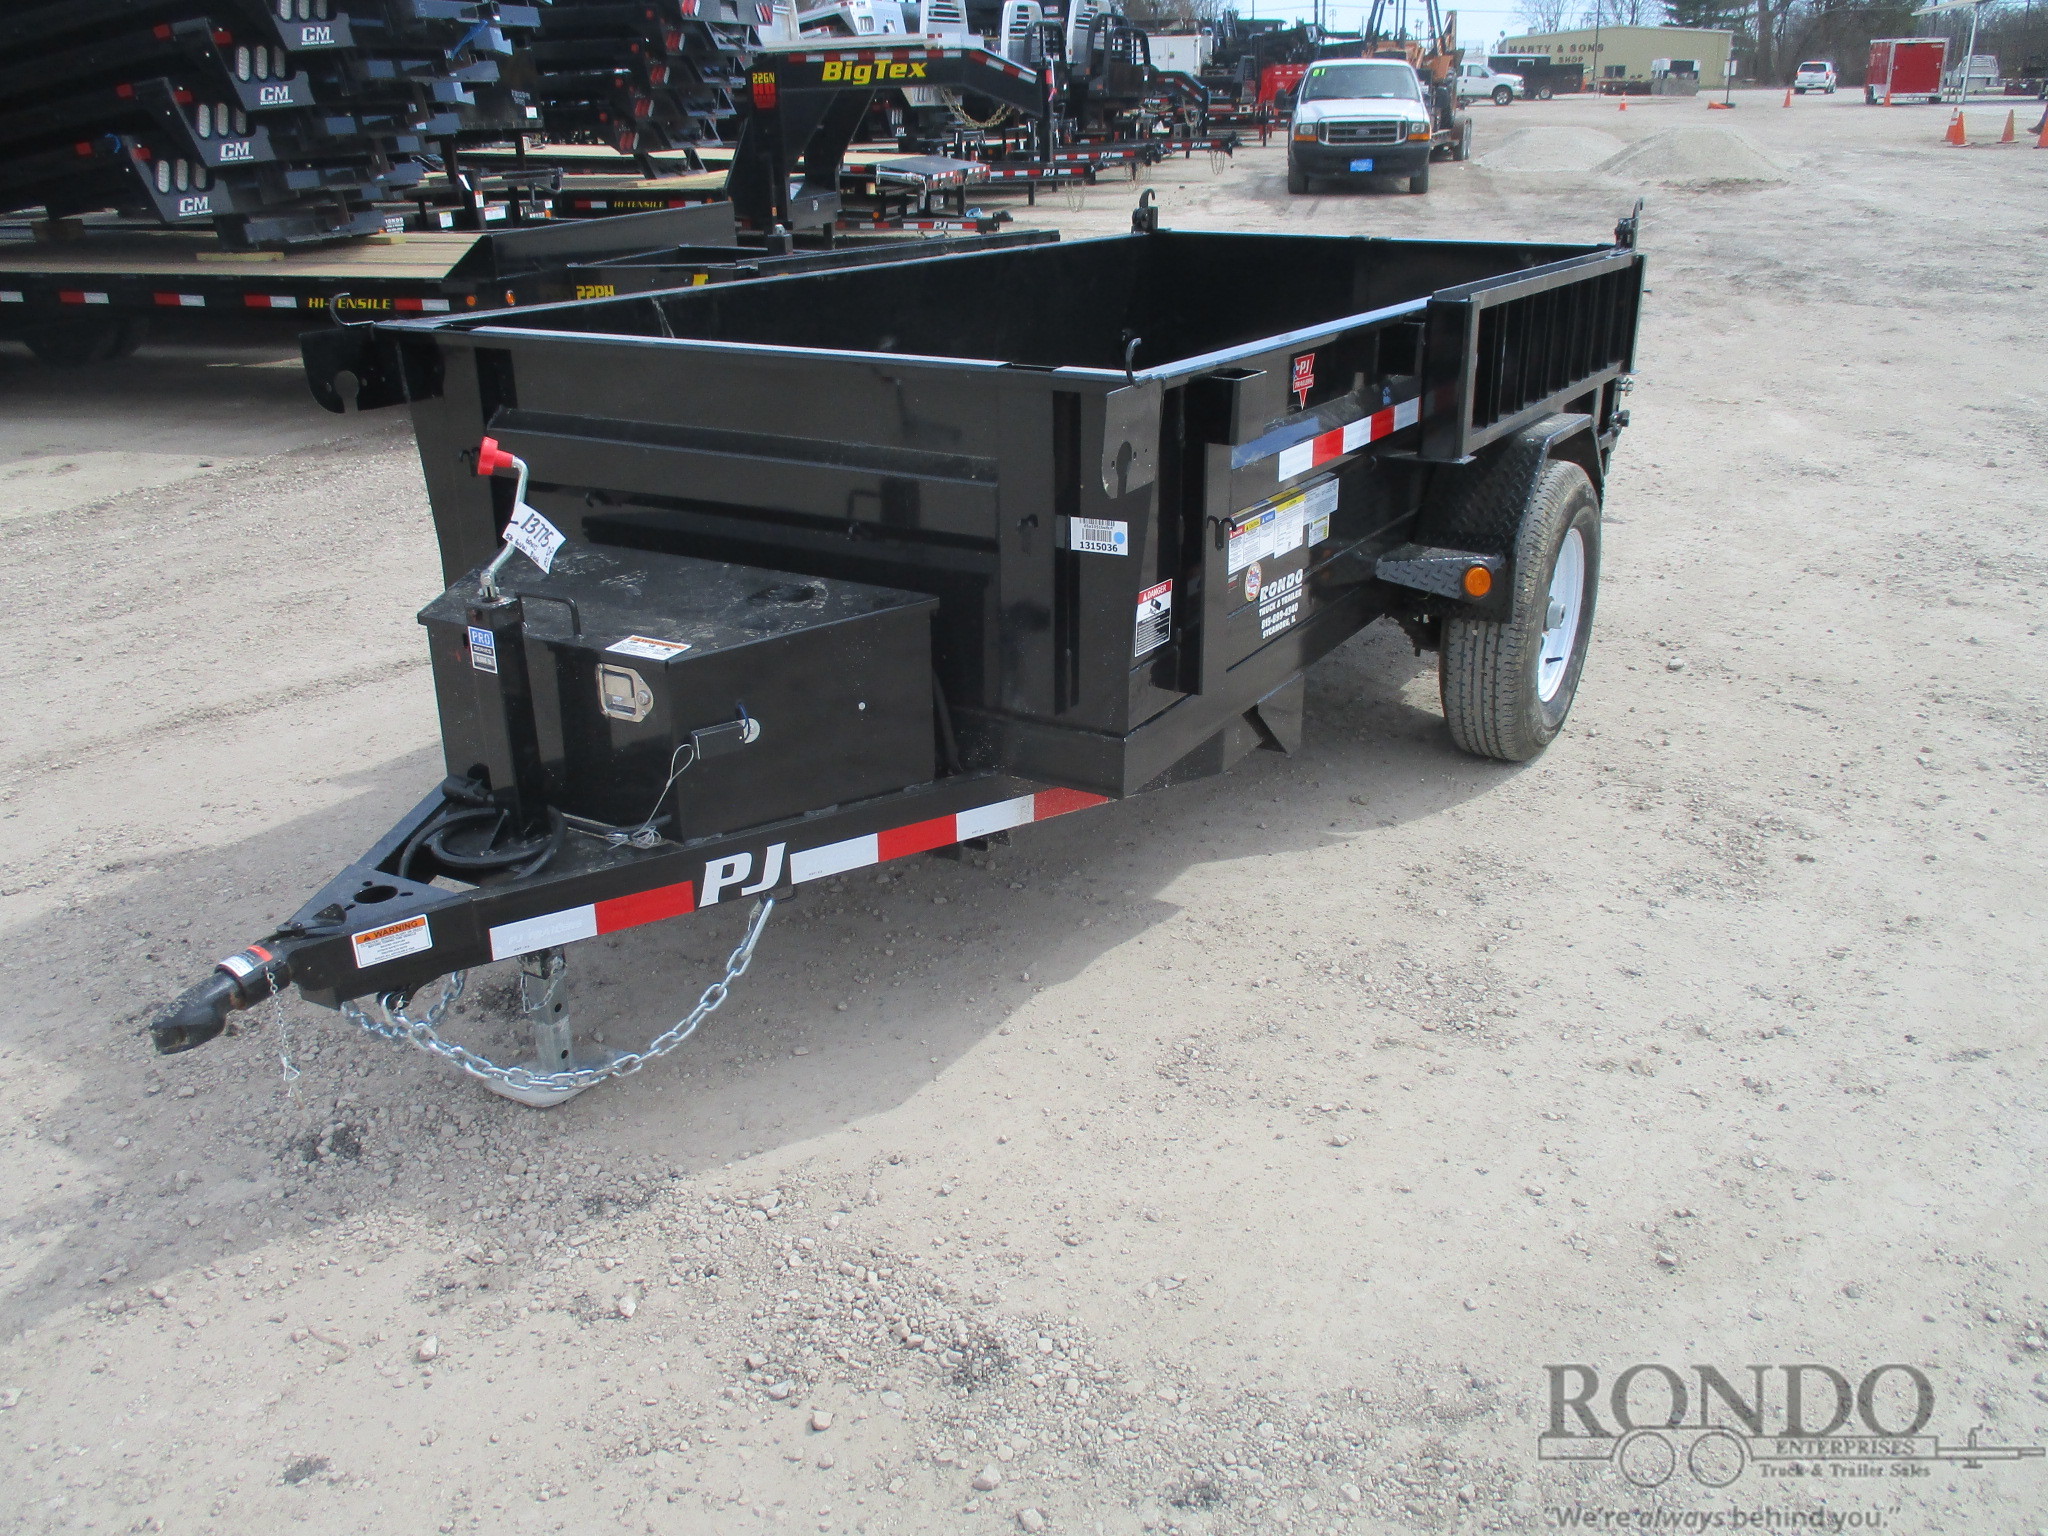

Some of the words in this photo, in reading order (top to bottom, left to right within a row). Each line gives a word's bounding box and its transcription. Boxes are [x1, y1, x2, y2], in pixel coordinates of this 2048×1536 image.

[302, 26, 330, 42] CM
[1508, 45, 1551, 54] MARTY
[1557, 44, 1564, 53] &
[1570, 43, 1604, 53] SONS
[260, 85, 289, 101] CM
[220, 142, 249, 158] CM
[1043, 168, 1056, 176] PJ
[179, 196, 208, 213] CM
[933, 221, 948, 230] PJ
[308, 297, 391, 311] HI-ENSILE
[1080, 541, 1118, 552] 1315036
[1147, 584, 1167, 599] DANGER
[1260, 569, 1303, 602] RONDO
[471, 630, 490, 645] PRO
[699, 842, 786, 908] PJ
[374, 920, 418, 938] WARNING
